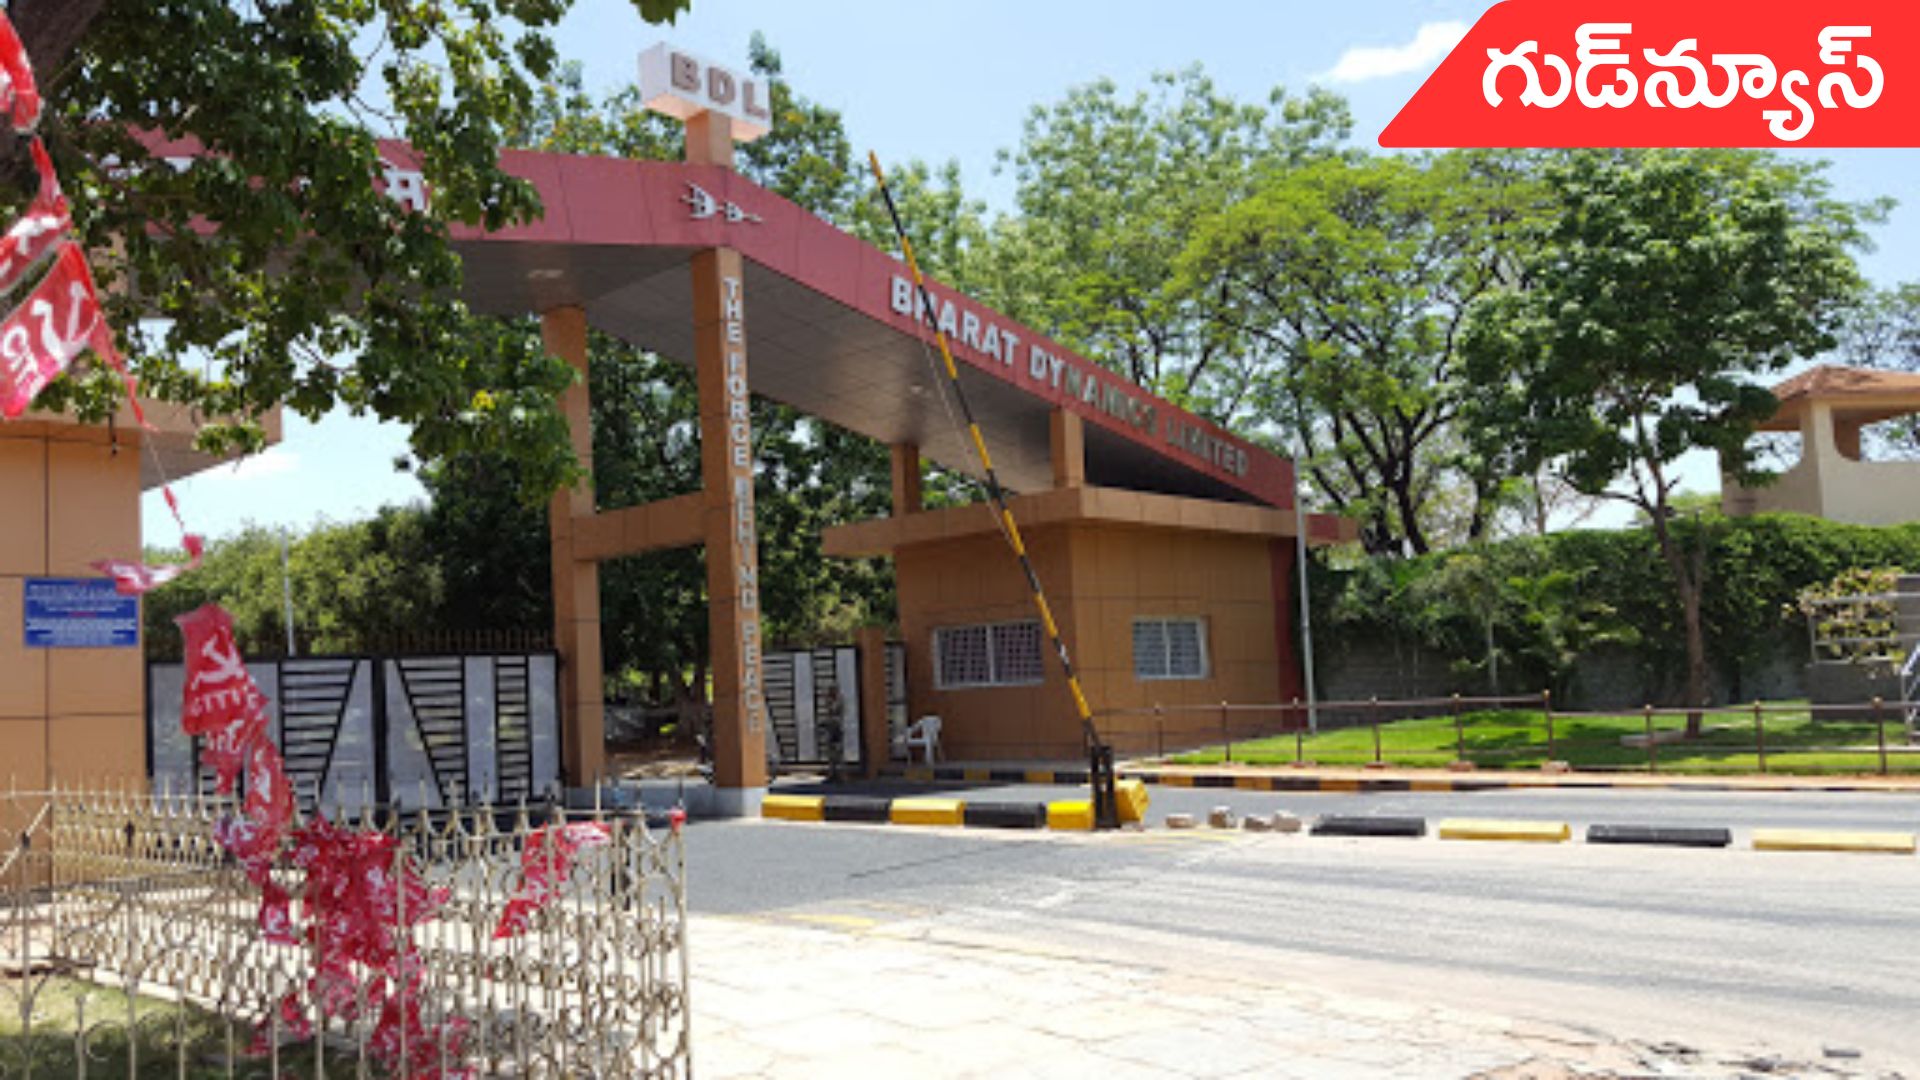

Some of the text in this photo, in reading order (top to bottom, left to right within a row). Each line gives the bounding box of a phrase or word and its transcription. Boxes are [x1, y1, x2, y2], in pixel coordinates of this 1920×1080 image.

[670, 51, 769, 119] BDL
[723, 277, 742, 344] THE
[727, 351, 750, 468] FORCE
[891, 274, 1249, 478] BHARAT DYNAMICS LIMITED
[741, 620, 761, 736] PEACE
